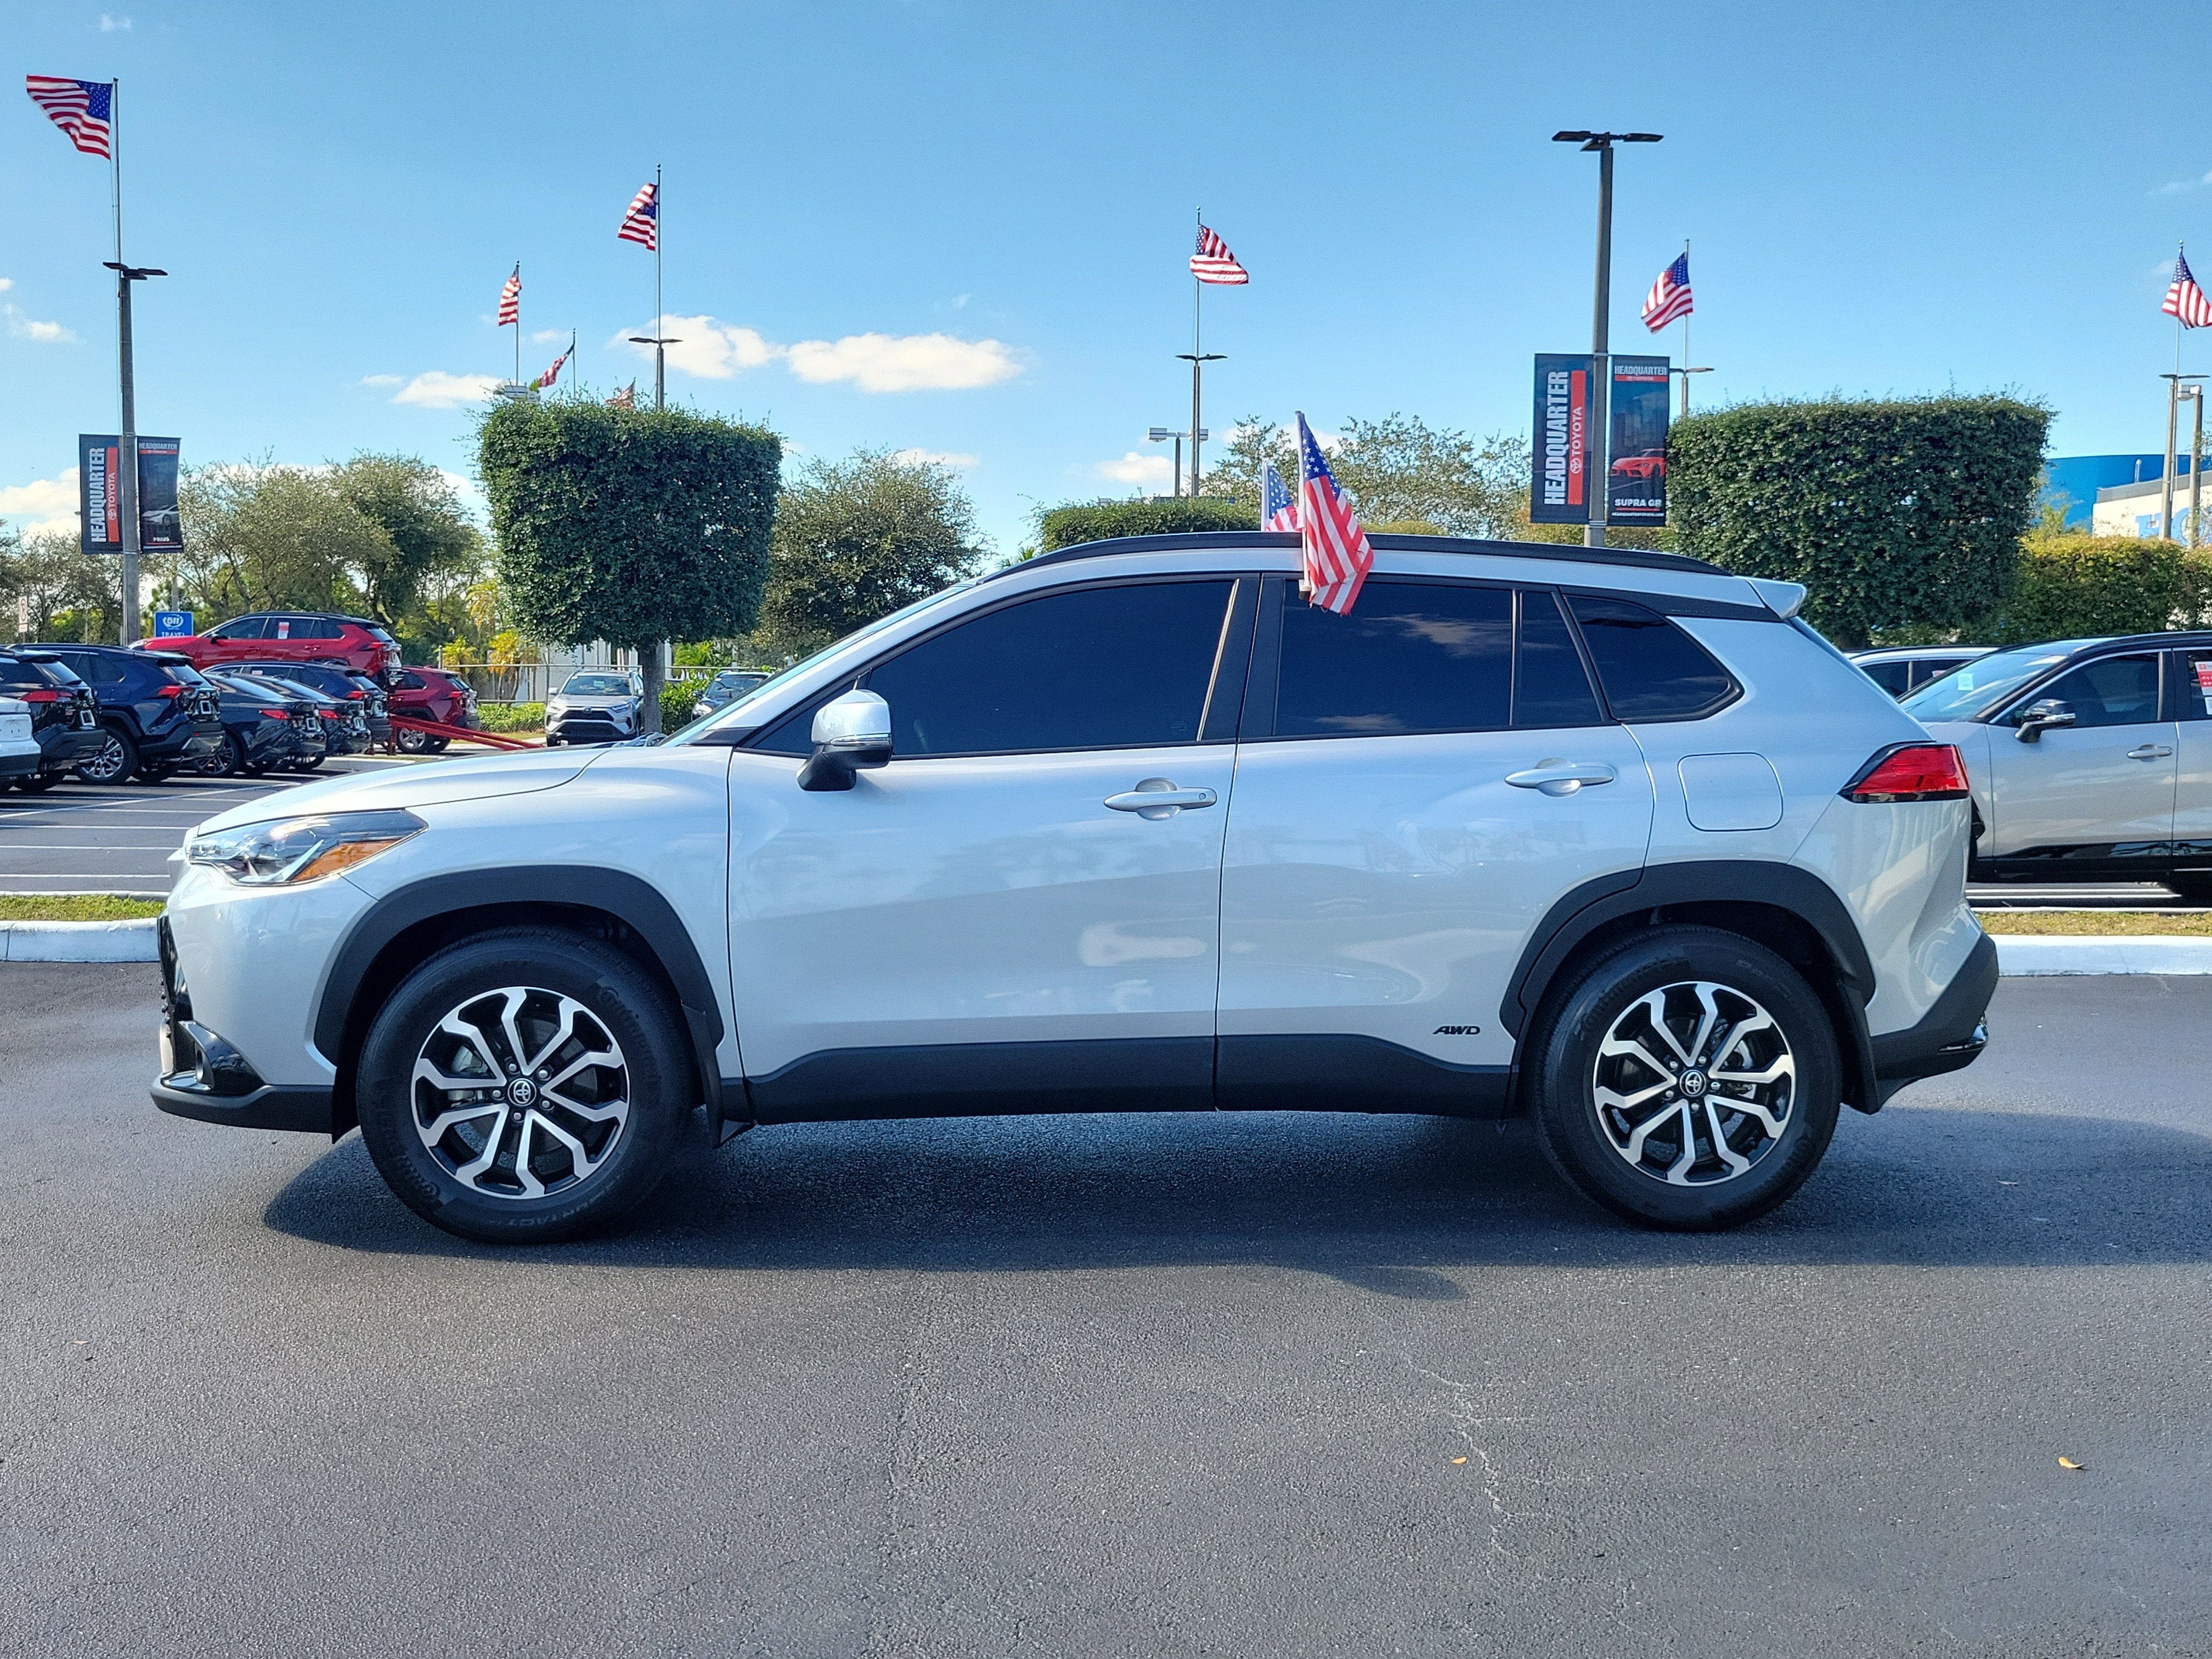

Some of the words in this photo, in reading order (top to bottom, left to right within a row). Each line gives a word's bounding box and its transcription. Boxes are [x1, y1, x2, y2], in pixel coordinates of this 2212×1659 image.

[1615, 365, 1667, 375] HEADQUARTER
[1544, 371, 1570, 505] HEADQUARTER
[1571, 407, 1583, 456] TOYOTA
[89, 448, 106, 542] HEADQUARTER
[1647, 499, 1662, 507] GR
[1432, 1025, 1481, 1035] AWD
